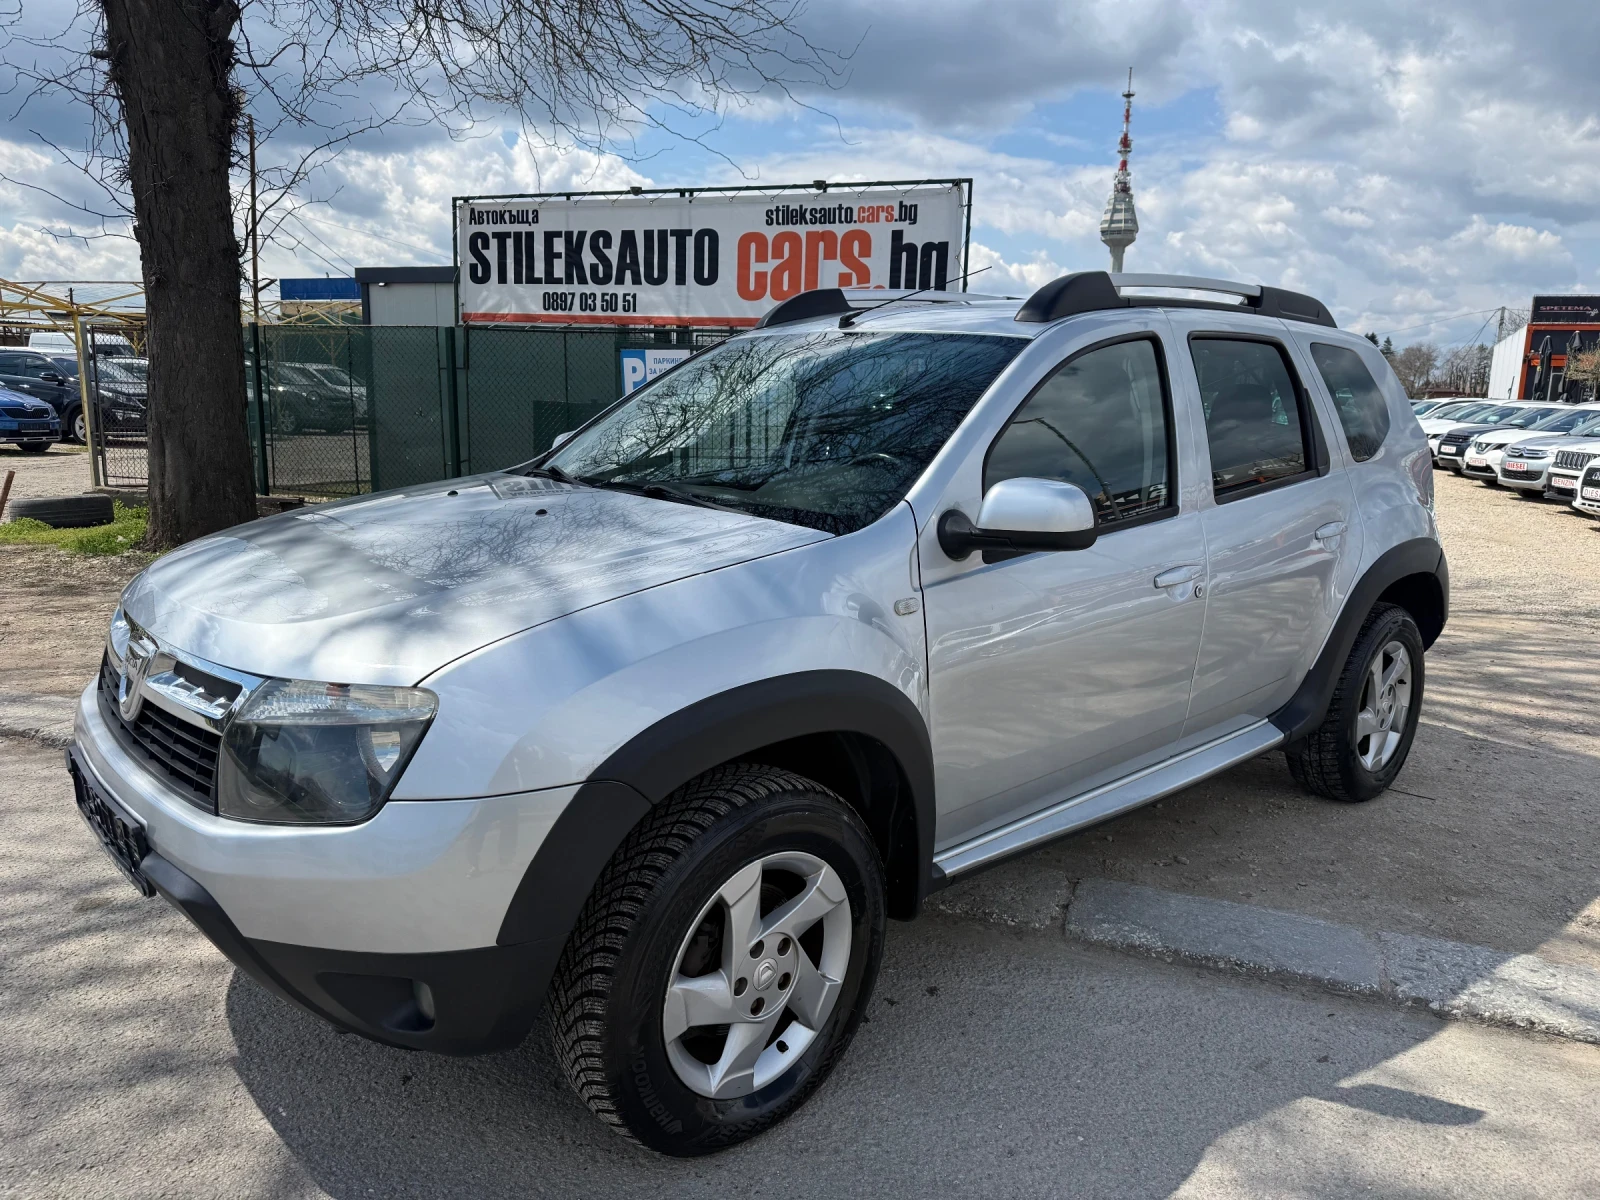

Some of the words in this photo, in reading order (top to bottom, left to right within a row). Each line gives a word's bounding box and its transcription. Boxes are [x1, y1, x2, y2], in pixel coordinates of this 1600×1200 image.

[468, 207, 539, 226] Автокъща
[766, 200, 918, 226] stileksauto.cars.bg
[468, 228, 719, 286] STILEKSAUTO
[542, 291, 576, 312] 0897
[579, 292, 597, 312] 03
[601, 292, 618, 312] 50
[622, 292, 637, 312] 51
[623, 357, 646, 395] P
[1506, 462, 1526, 470] DIESEL
[1553, 477, 1575, 487] BENZIN
[1584, 488, 1600, 498] DIES
